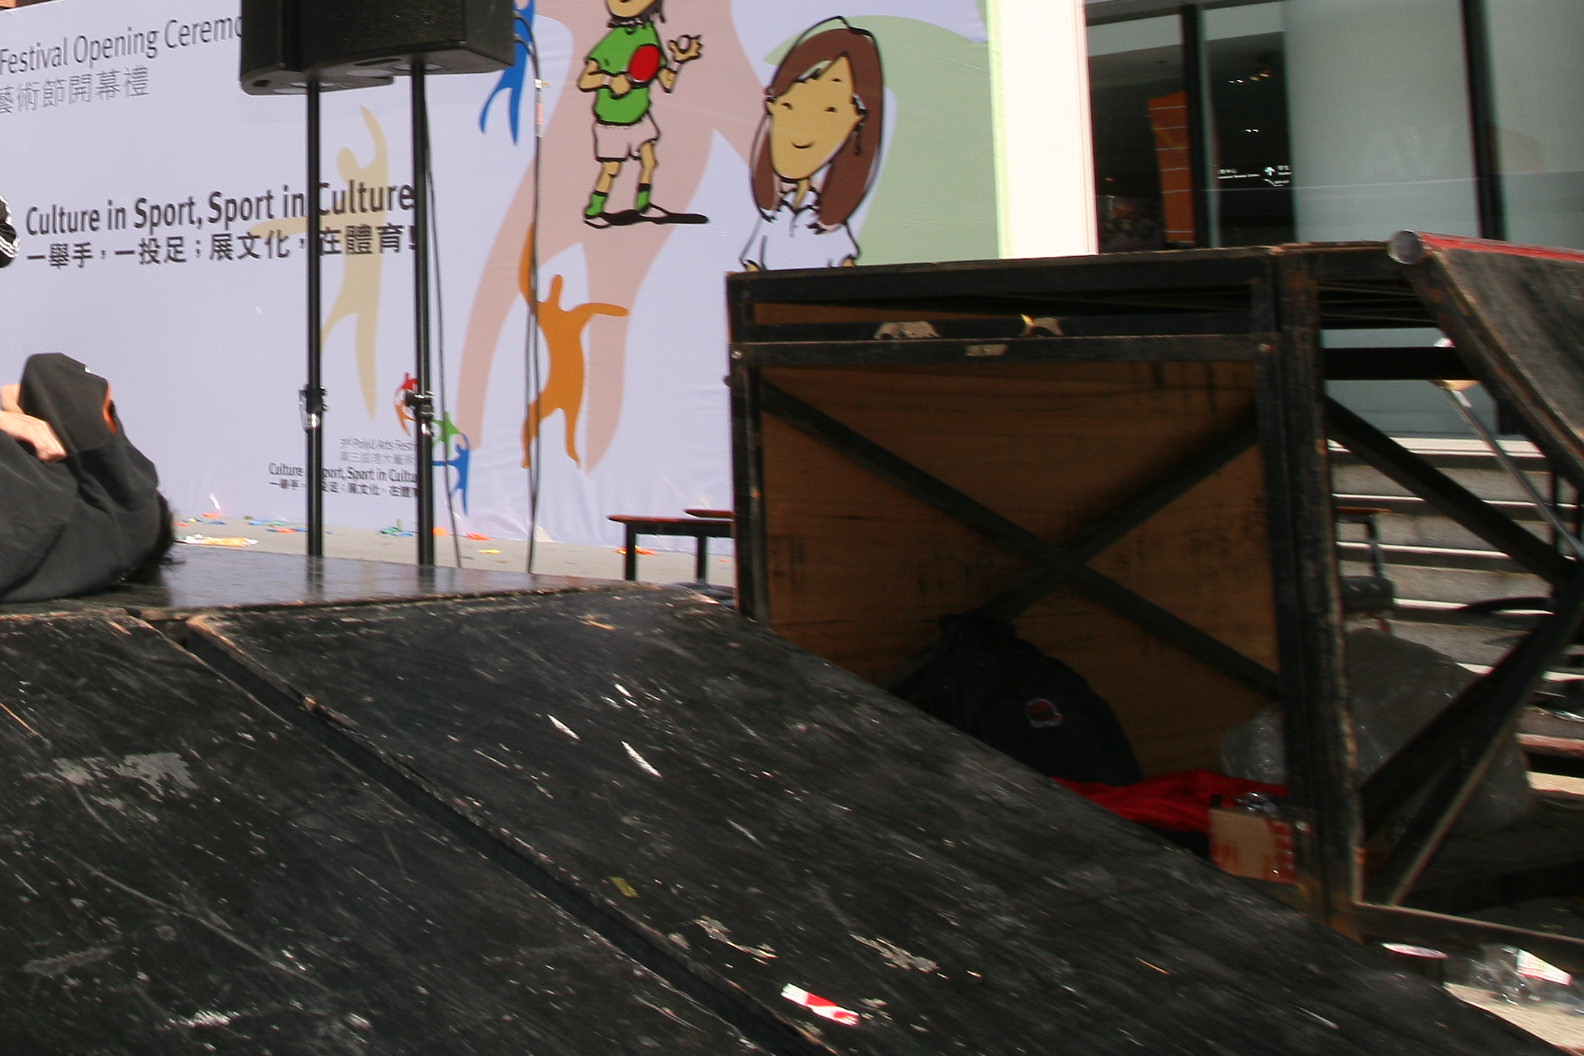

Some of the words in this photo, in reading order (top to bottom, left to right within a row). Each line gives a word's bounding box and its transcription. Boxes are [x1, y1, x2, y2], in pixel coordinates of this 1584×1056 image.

[73, 26, 160, 68] Opening
[164, 16, 243, 49] Ceremo
[26, 204, 101, 236] Culture
[108, 199, 127, 231] in
[133, 195, 203, 236] Sport,
[207, 190, 275, 231] Sport
[283, 184, 306, 218] in
